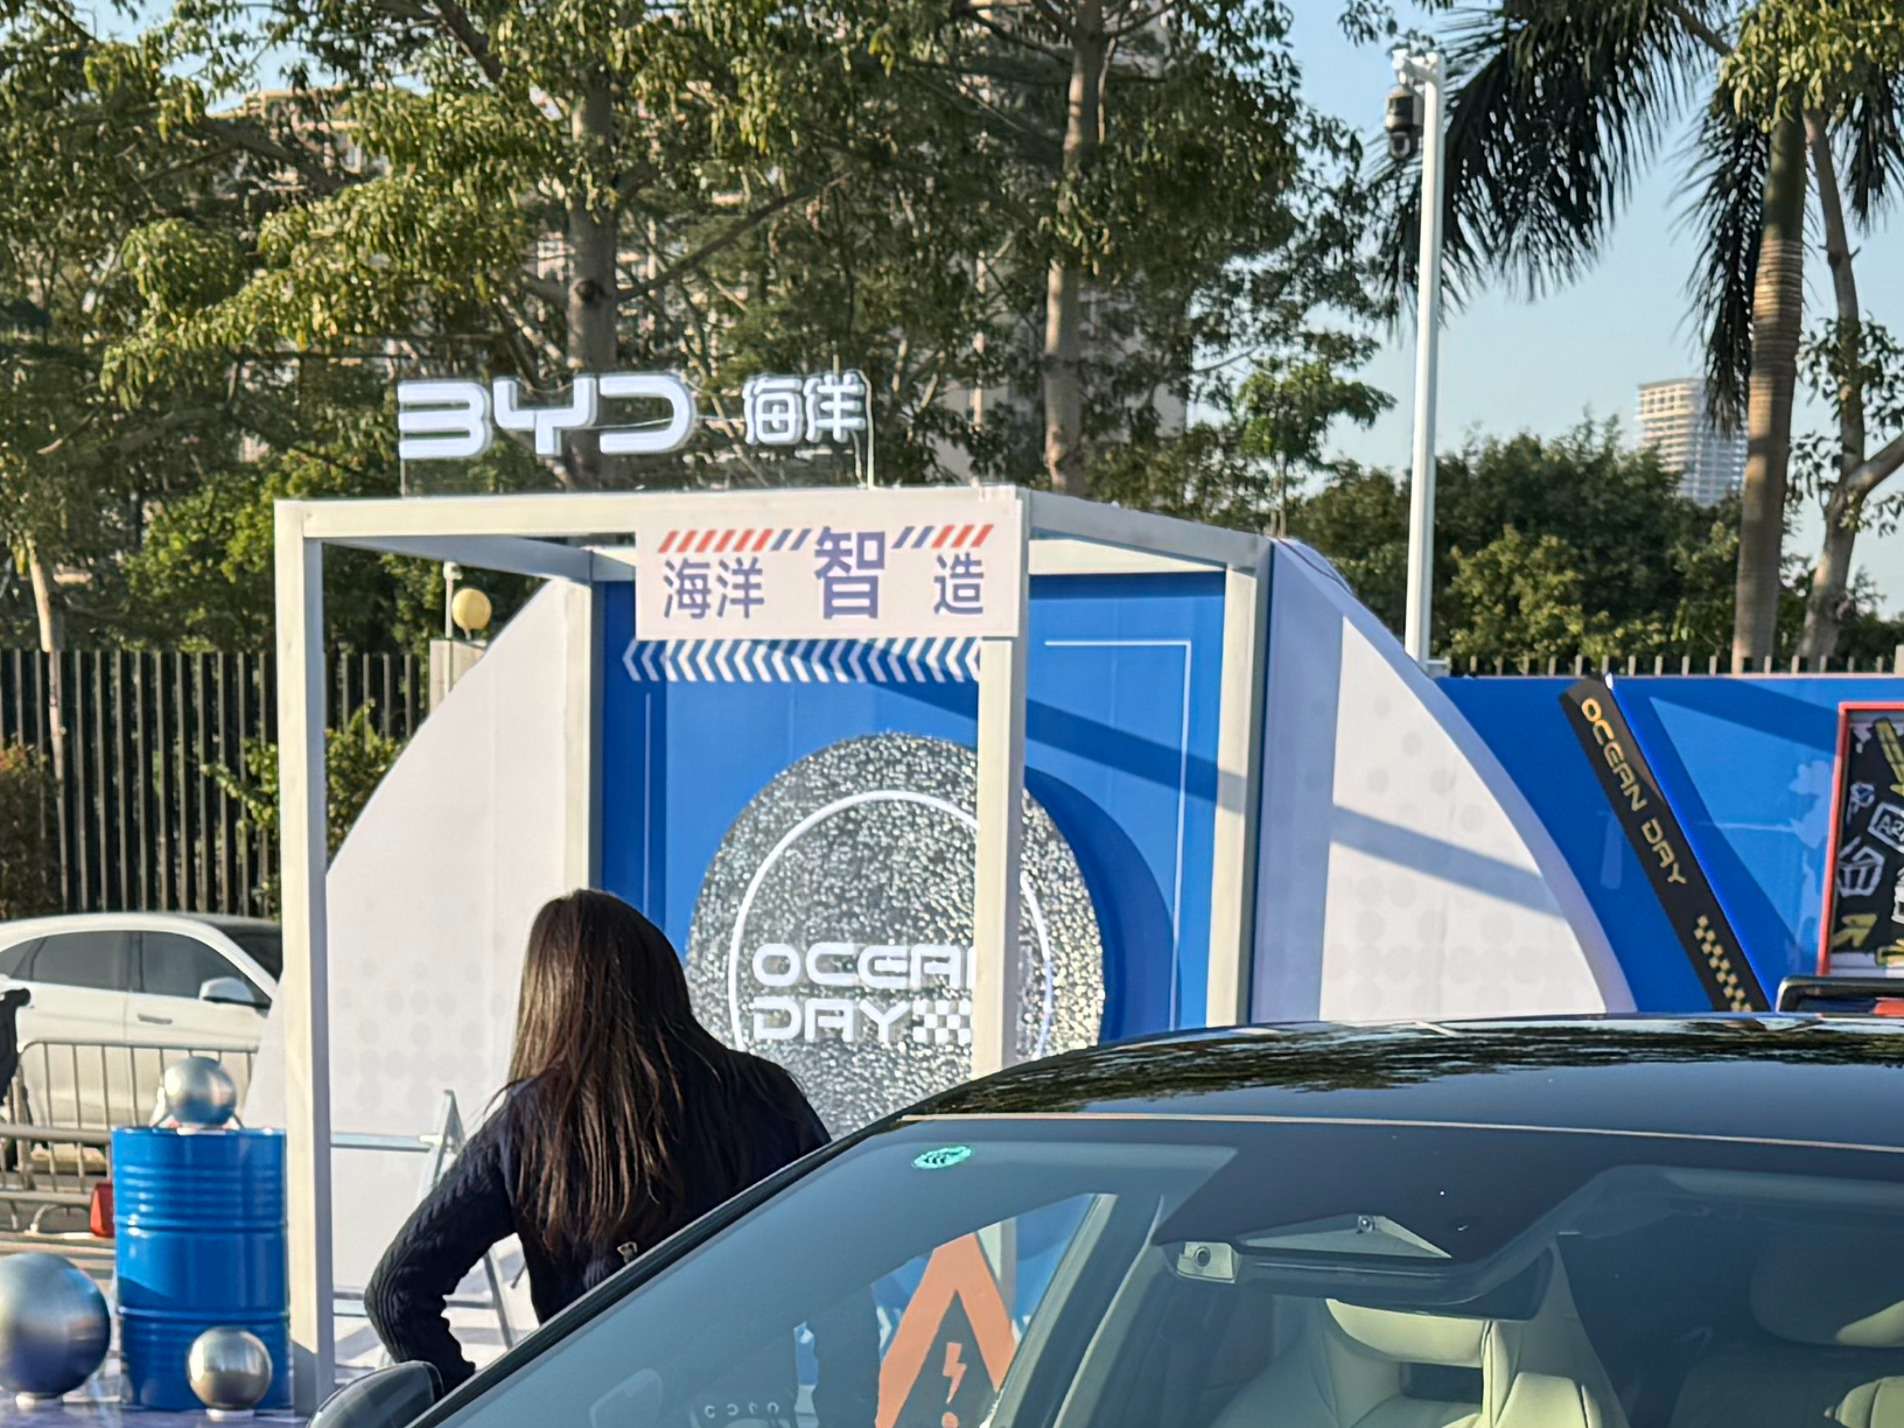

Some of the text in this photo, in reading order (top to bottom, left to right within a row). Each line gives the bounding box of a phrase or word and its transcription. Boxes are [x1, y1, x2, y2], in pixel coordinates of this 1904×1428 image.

[398, 374, 693, 458] BYD
[1581, 698, 1687, 884] OCEAN DAY
[752, 942, 976, 989] OCEA
[753, 997, 911, 1042] DAY
